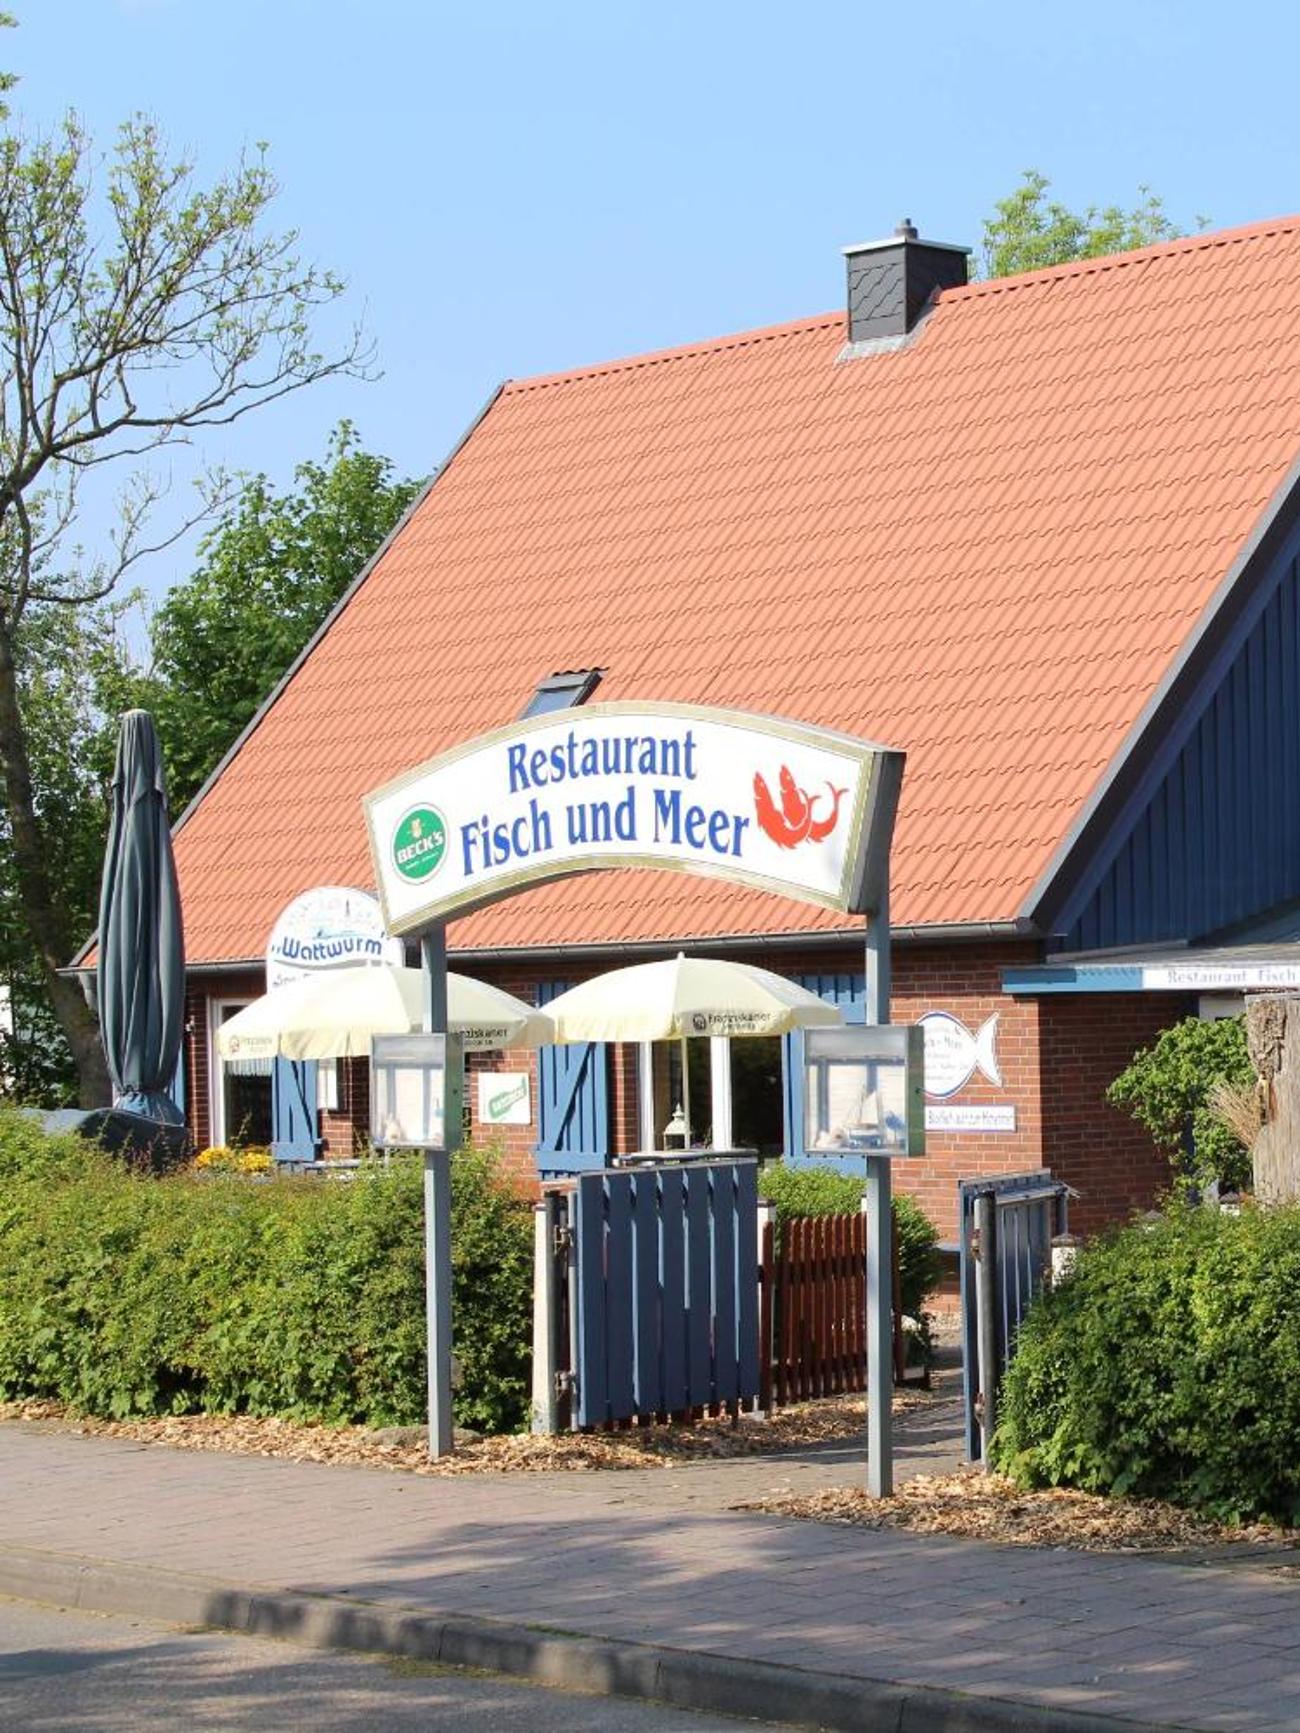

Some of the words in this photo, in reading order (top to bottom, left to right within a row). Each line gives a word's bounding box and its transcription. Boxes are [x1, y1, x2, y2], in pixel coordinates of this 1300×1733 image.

[507, 730, 698, 793] Restaurant
[397, 831, 443, 865] BECK'S
[460, 798, 553, 876] Fisch
[566, 785, 637, 845] und
[653, 789, 750, 857] Meer
[1167, 968, 1248, 985] Restaurant
[1259, 967, 1297, 983] Fisch
